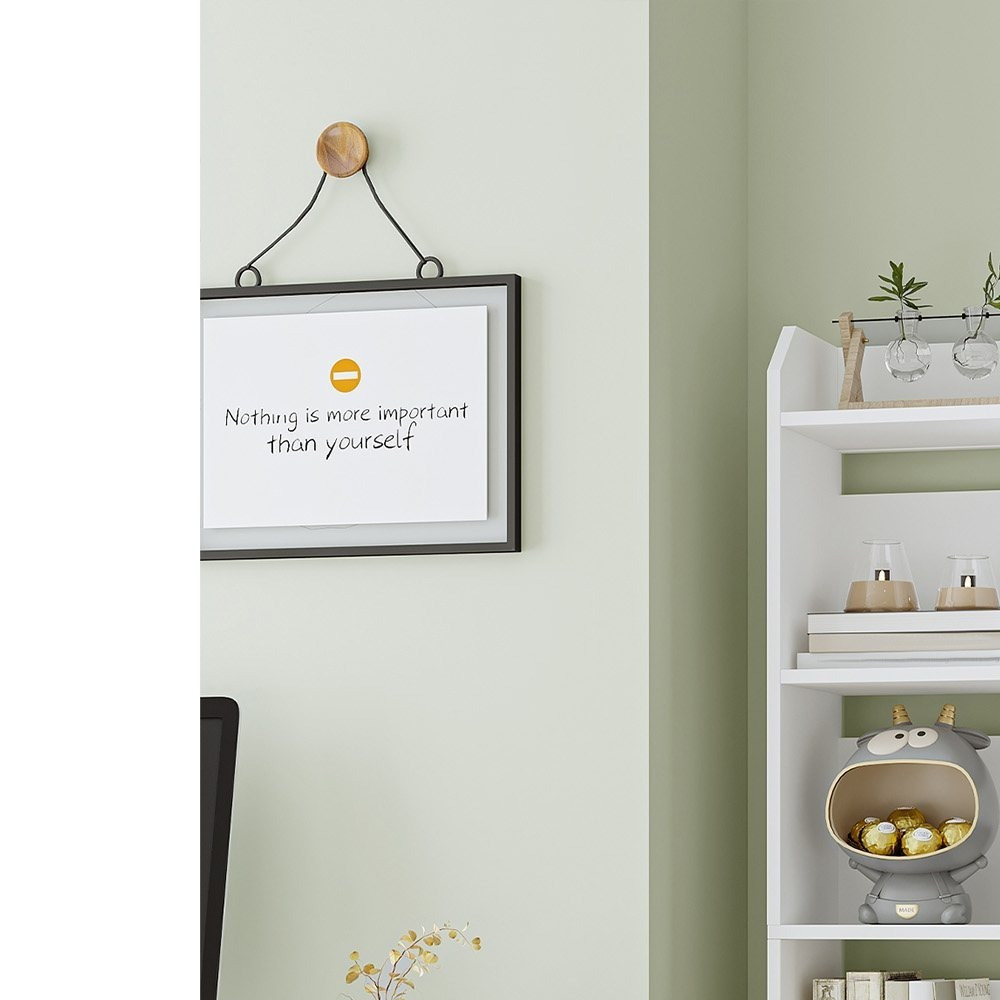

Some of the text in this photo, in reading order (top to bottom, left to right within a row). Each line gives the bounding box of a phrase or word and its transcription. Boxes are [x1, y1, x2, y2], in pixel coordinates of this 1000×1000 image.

[225, 402, 469, 432] Nothing is more important
[267, 421, 417, 460] than yourself
